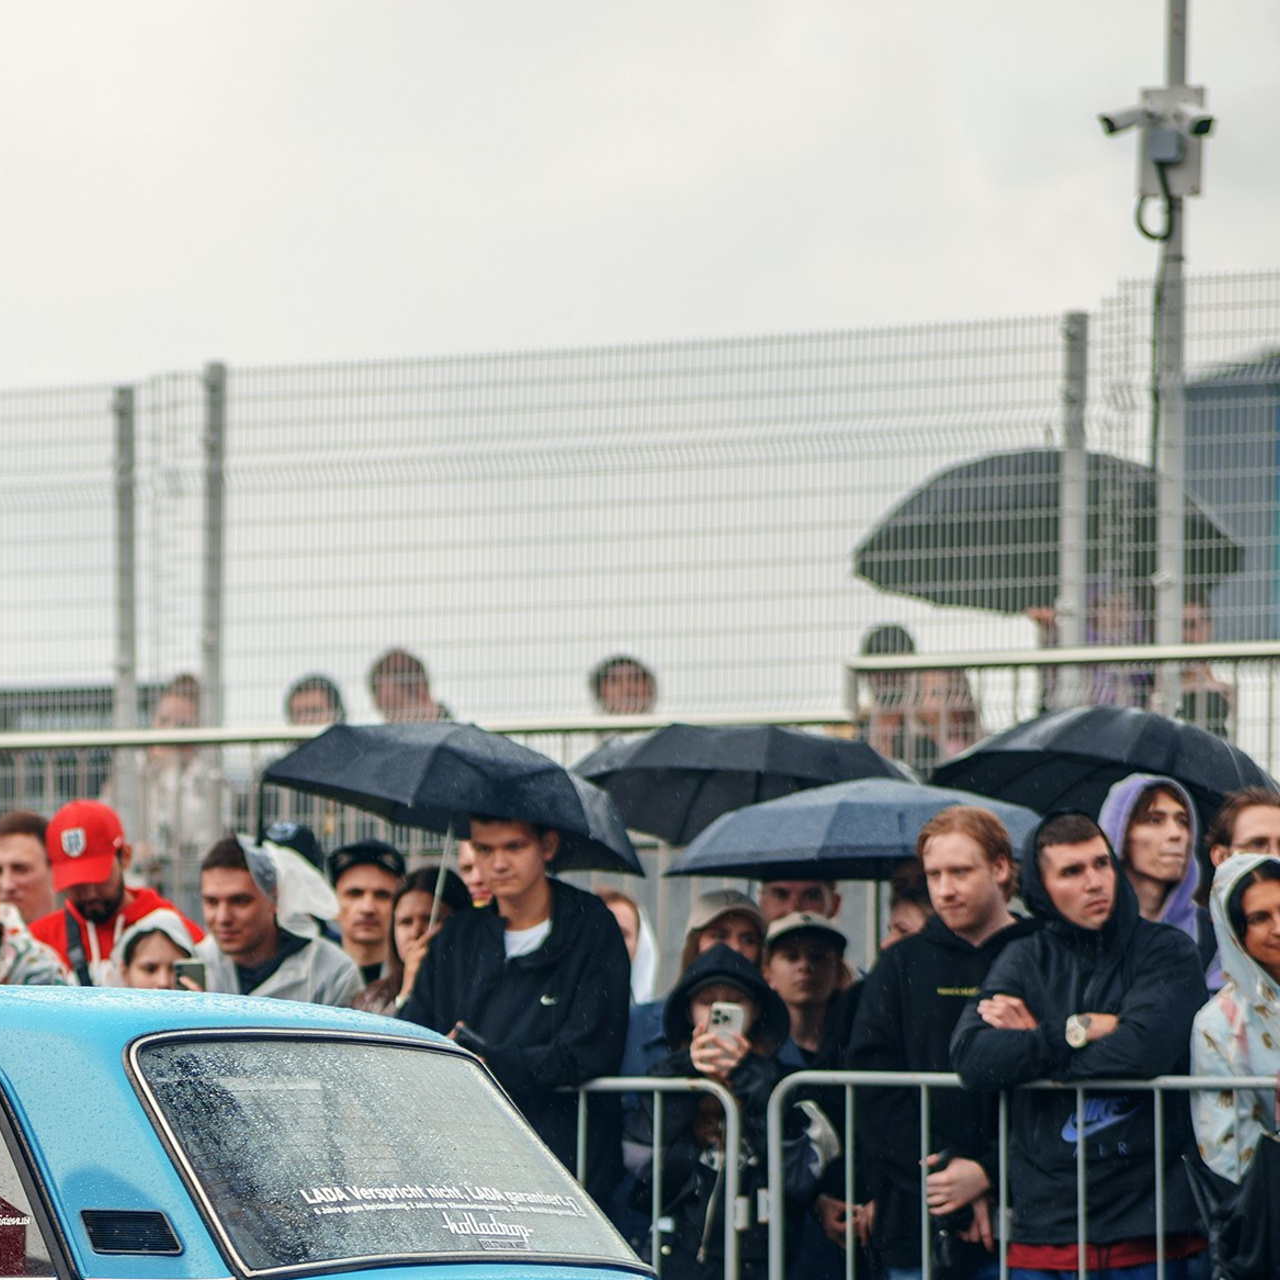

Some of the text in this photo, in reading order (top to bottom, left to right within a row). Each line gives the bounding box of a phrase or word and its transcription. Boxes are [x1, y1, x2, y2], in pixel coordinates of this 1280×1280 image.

[299, 1187, 350, 1204] LADA
[344, 1184, 427, 1202] Verspricht
[463, 1185, 507, 1201] LADA
